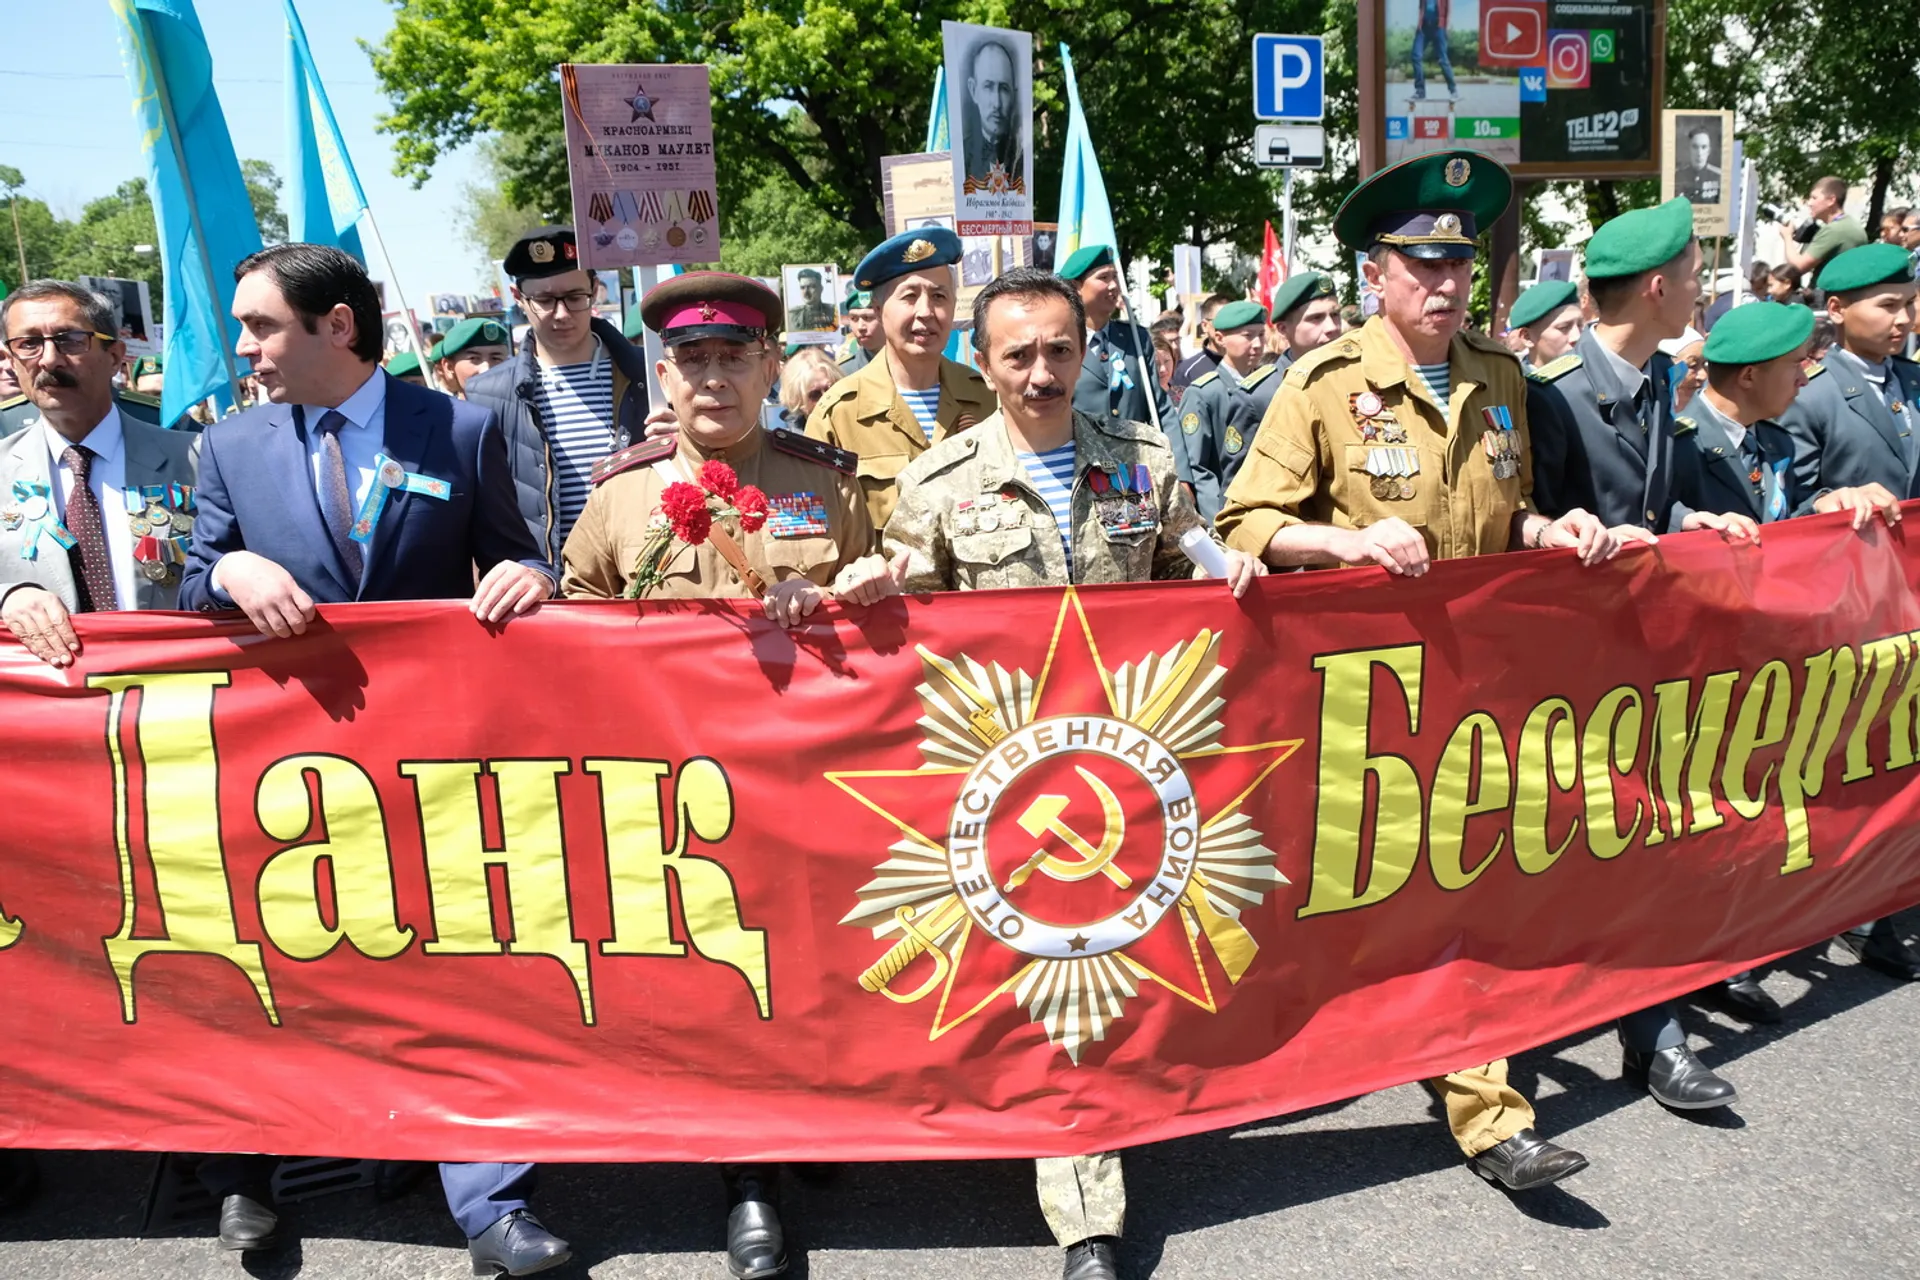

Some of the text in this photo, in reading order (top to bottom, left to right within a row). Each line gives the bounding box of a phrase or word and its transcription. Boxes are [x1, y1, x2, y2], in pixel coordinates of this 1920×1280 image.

[1273, 44, 1312, 112] P
[603, 125, 693, 136] КРАСНОАРМЕЕЦ
[1565, 110, 1619, 138] TELE2
[658, 142, 711, 155] МАУЛЕТ
[961, 221, 1013, 235] БЕССМЕРТНЫЙ
[950, 720, 1194, 941] ОТЕЧЕСТВЕННАЯ ВОЙНА
